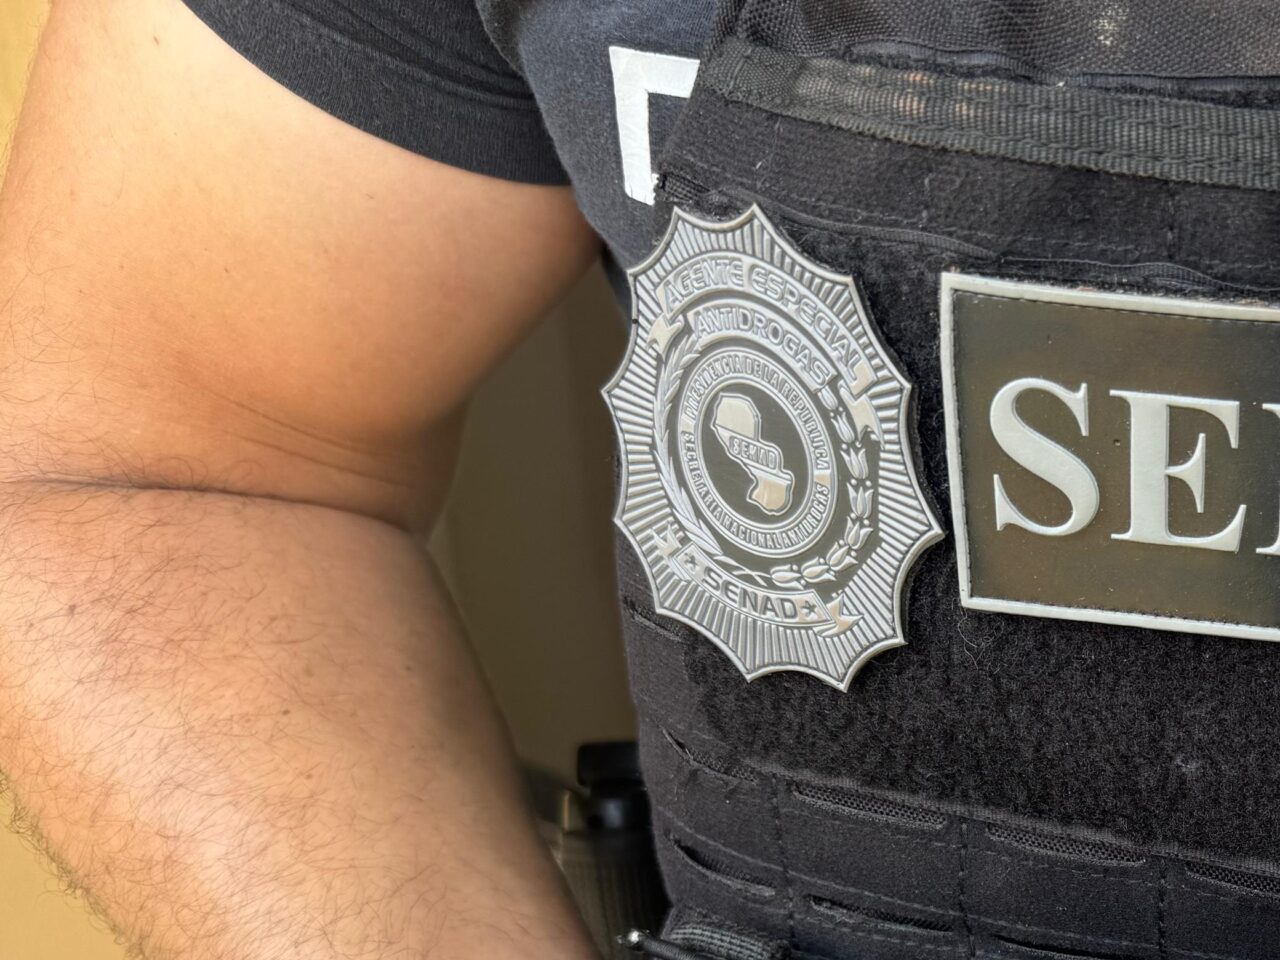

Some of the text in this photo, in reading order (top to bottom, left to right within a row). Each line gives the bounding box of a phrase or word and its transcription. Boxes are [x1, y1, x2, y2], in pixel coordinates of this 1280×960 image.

[664, 256, 862, 380] AGENTE ESPECIAL
[692, 306, 831, 387] ANTIDROGAS
[744, 356, 761, 377] DE
[762, 361, 779, 388] LA
[729, 435, 778, 470] SENAD
[721, 516, 781, 549] NACIONAL
[702, 566, 797, 619] SENAD
